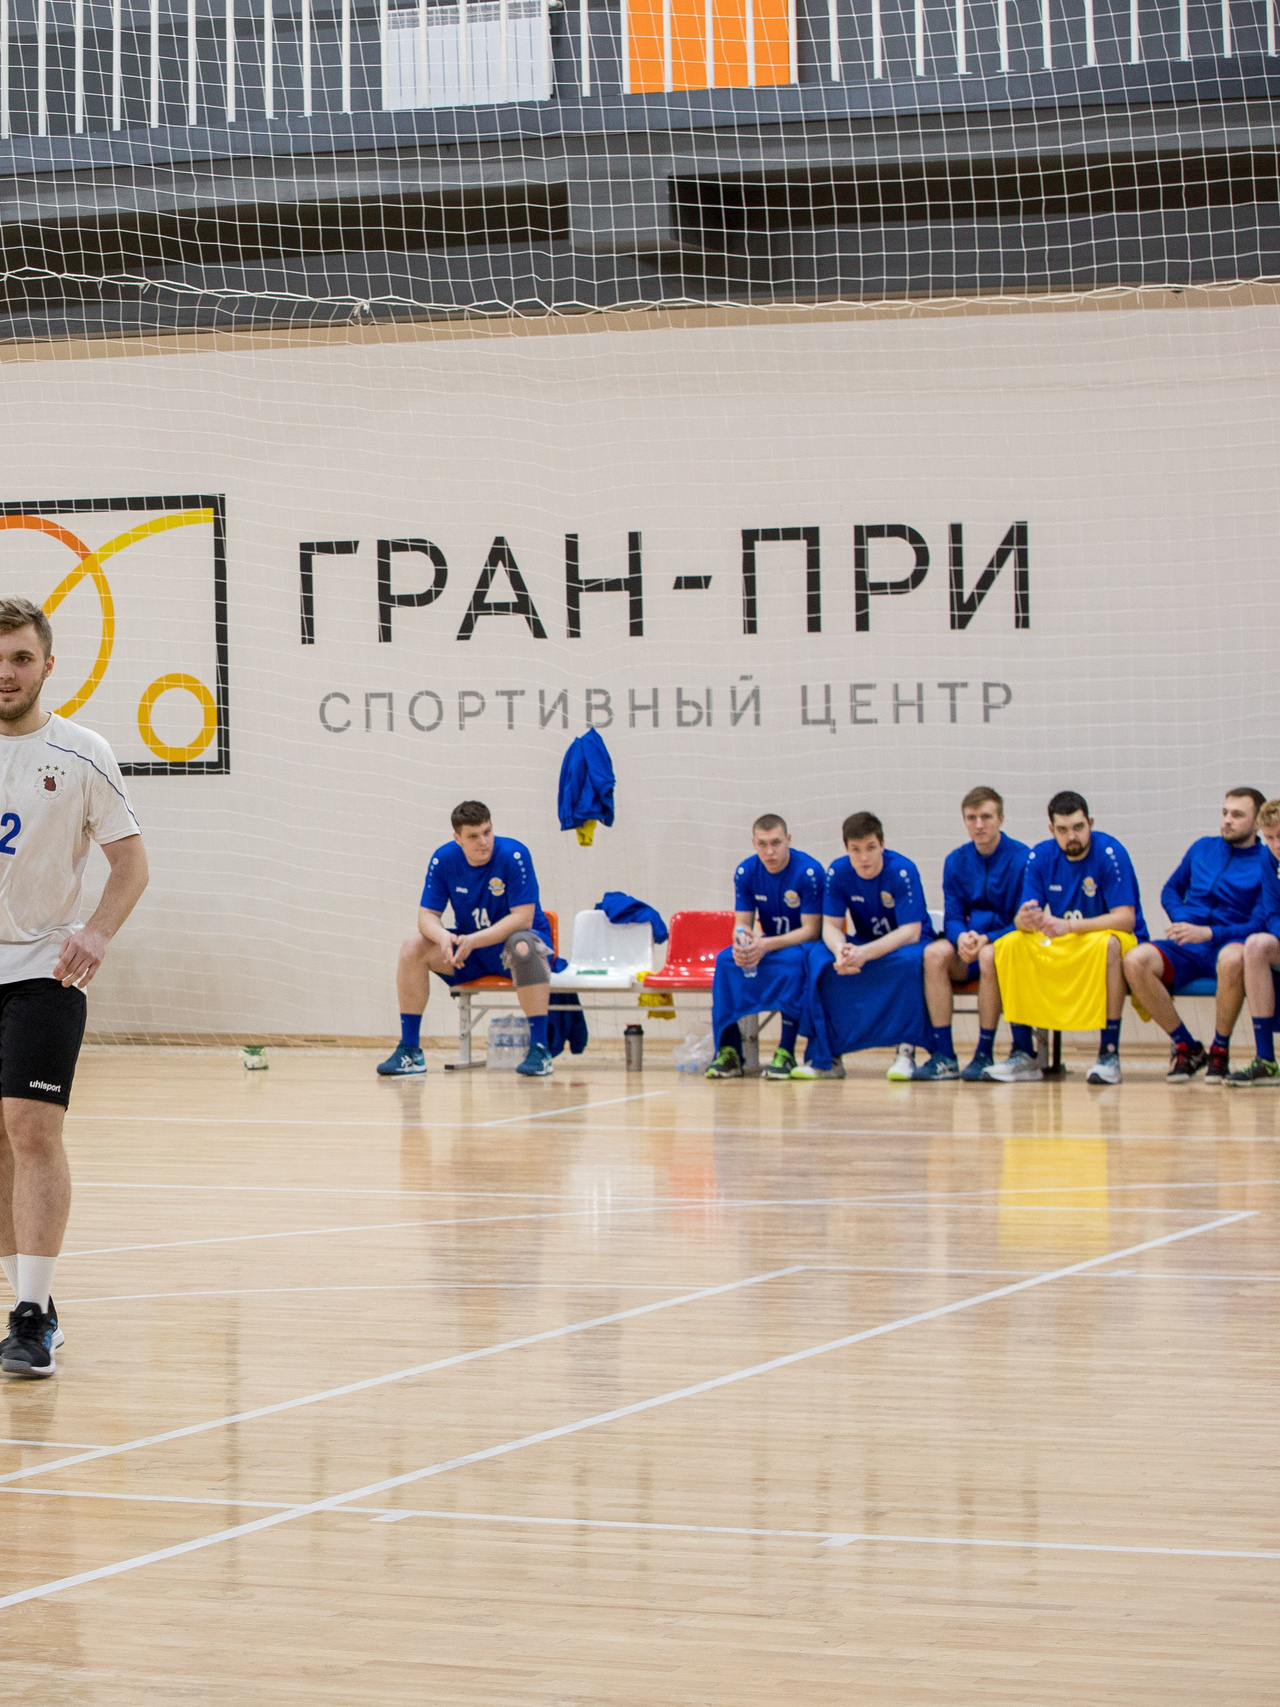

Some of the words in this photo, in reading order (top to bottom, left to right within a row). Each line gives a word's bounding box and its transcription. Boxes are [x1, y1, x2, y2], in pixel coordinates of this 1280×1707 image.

[299, 520, 1030, 645] ГРАН-ПРИ
[319, 674, 762, 734] СПОРТИВНЫЙ
[800, 682, 1013, 734] ЦЕНТР
[471, 907, 491, 930] 14
[871, 917, 892, 935] 21
[29, 1080, 61, 1092] uhlsport
